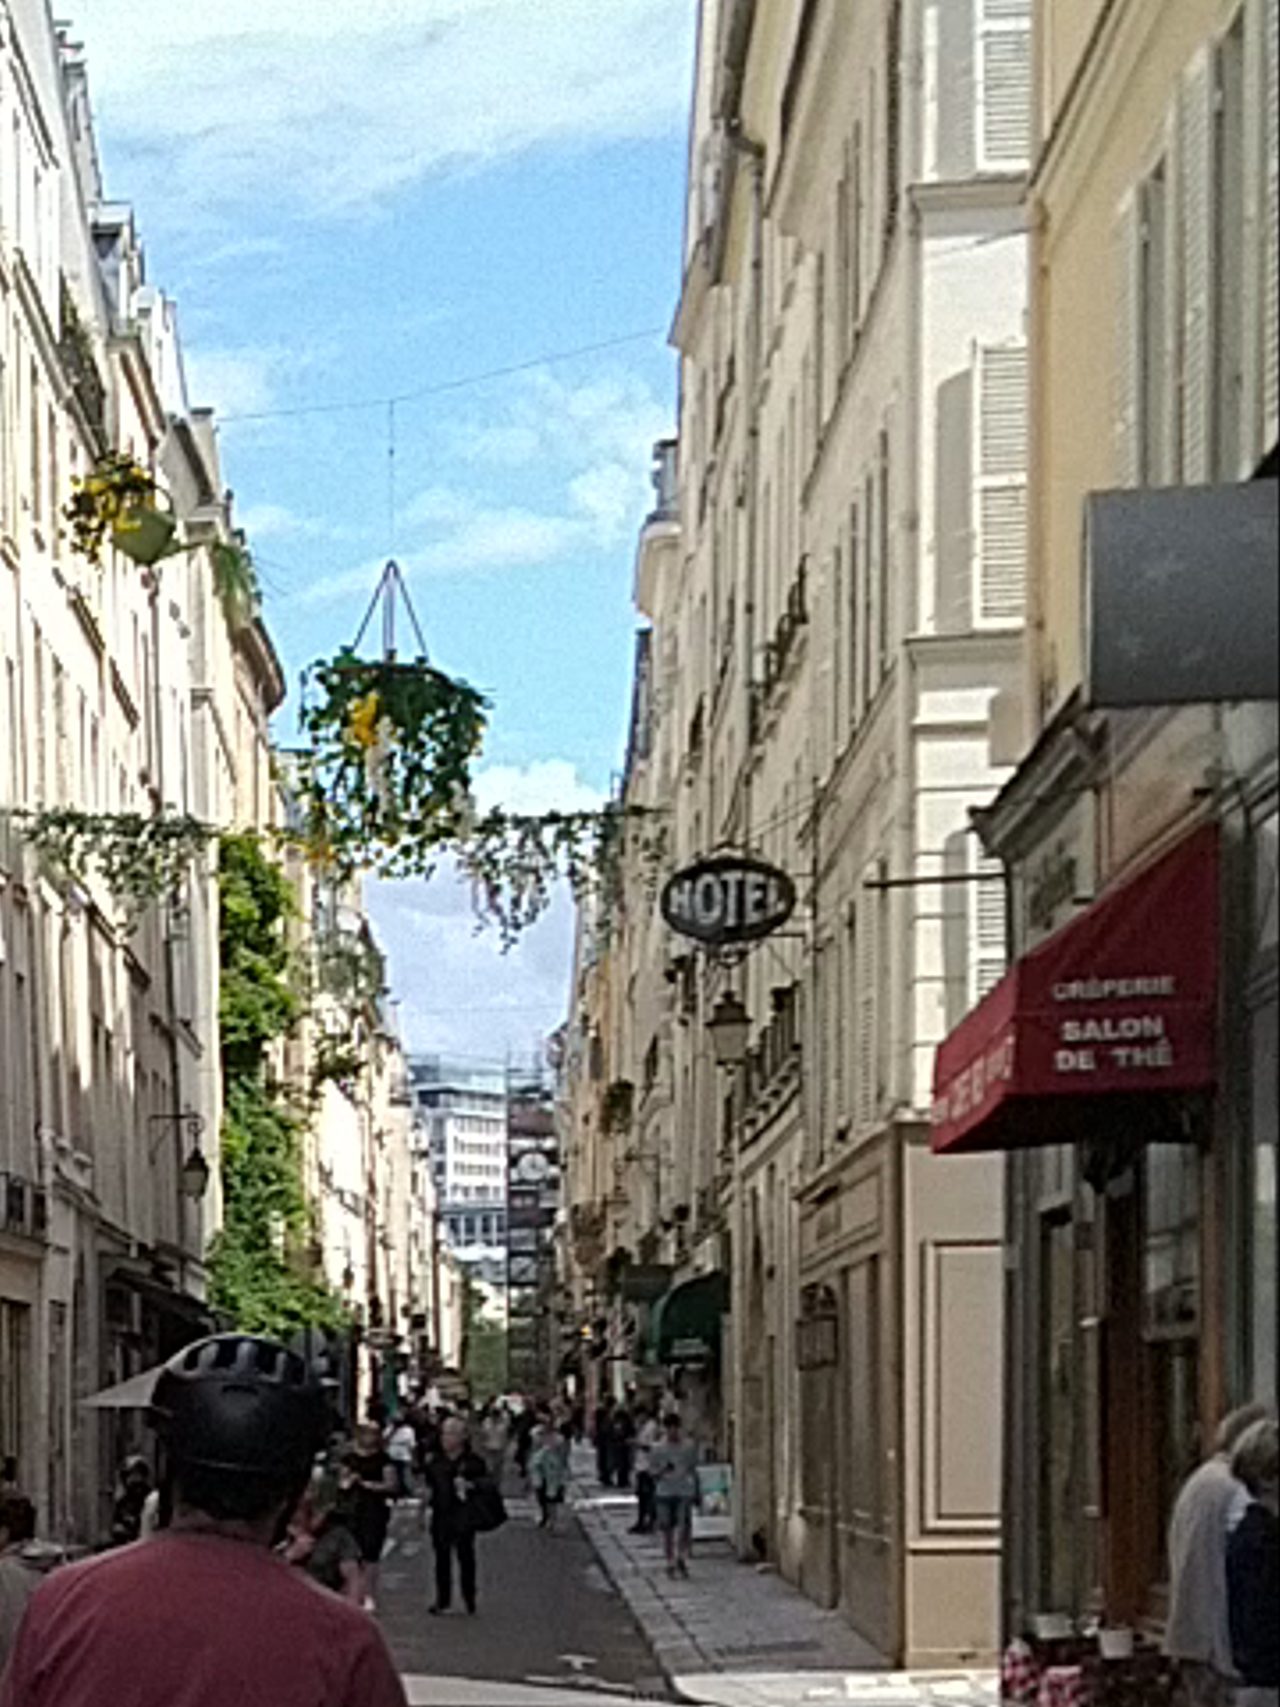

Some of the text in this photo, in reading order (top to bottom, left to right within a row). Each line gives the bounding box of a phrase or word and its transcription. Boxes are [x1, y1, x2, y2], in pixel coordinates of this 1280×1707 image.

[670, 870, 786, 927] HOTEL
[1061, 1016, 1164, 1041] SALON
[1055, 1049, 1096, 1071] DE
